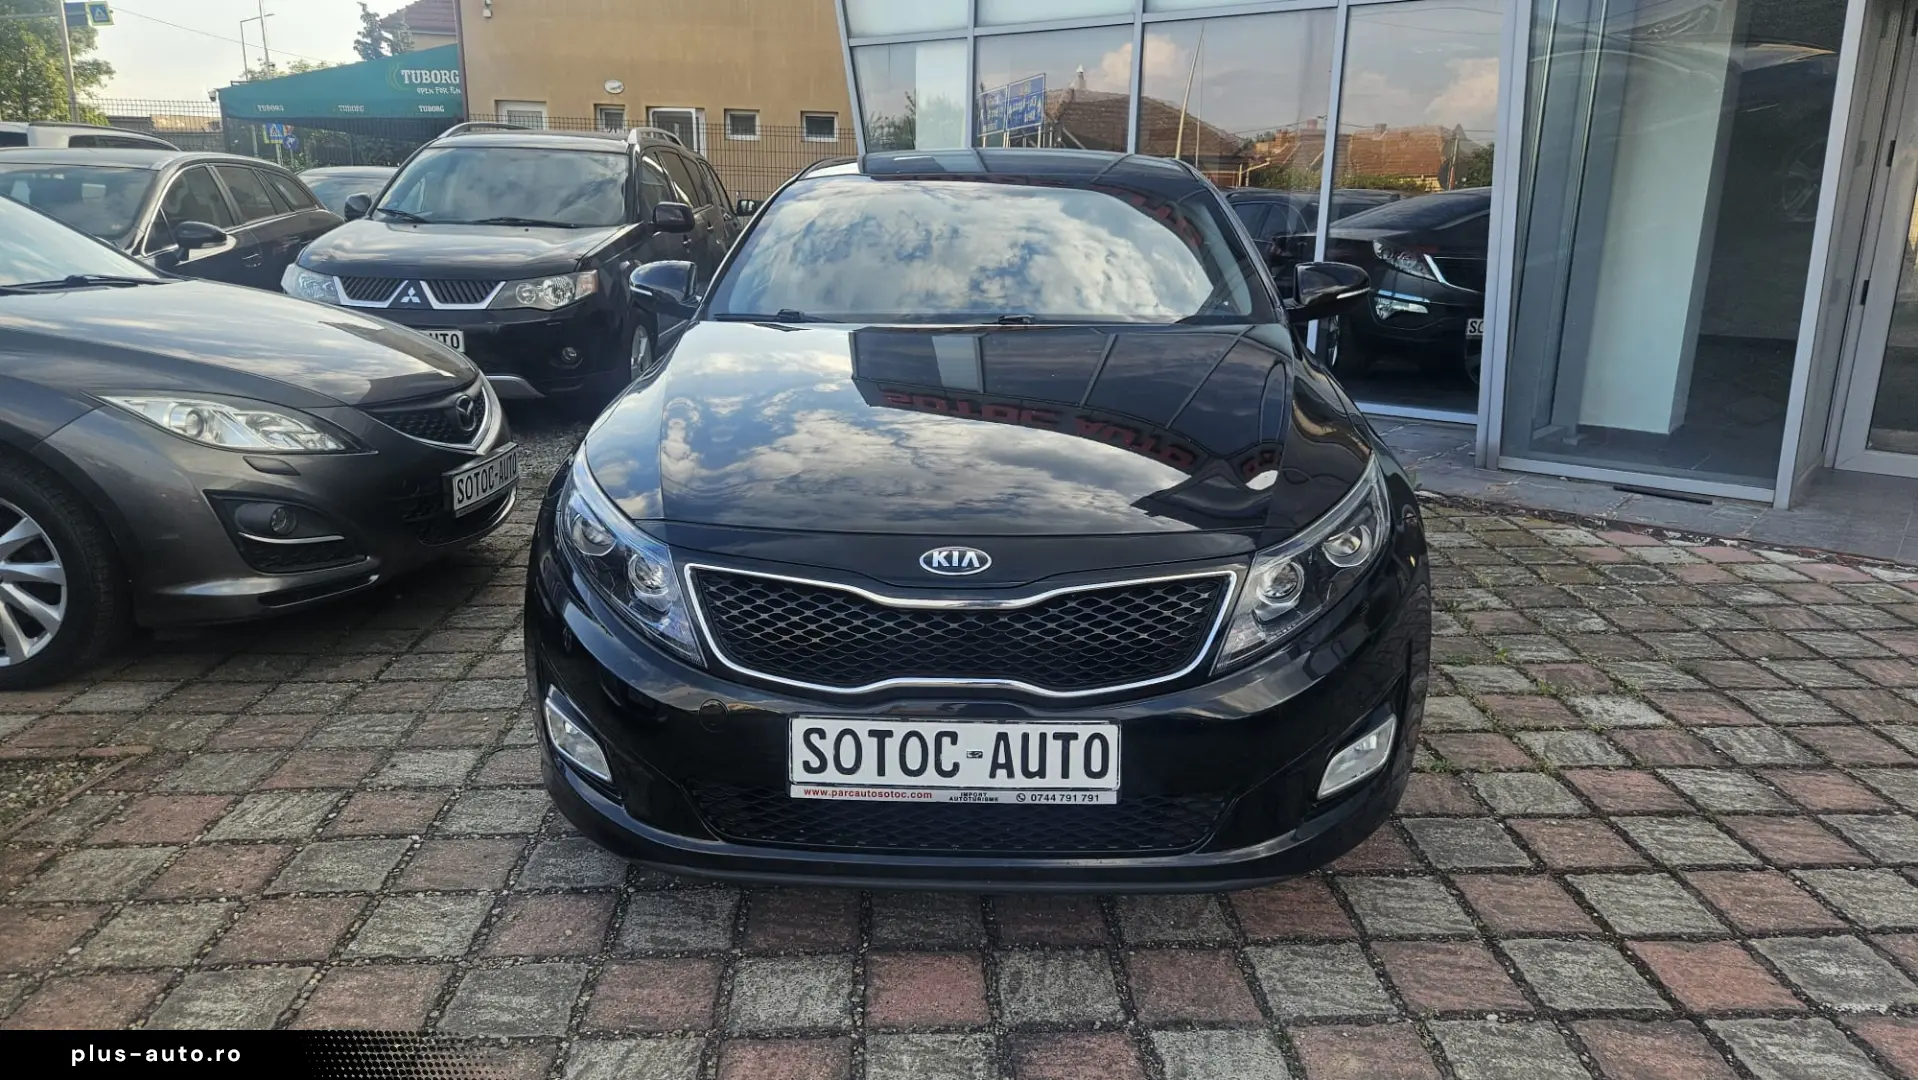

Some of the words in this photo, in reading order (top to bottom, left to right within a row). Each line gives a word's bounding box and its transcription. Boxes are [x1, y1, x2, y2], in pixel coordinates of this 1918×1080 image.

[401, 69, 460, 84] TUBORG
[932, 551, 980, 568] KIA
[803, 788, 933, 799] www.parcautosotoc.com
[1030, 793, 1056, 802] 0744
[1060, 793, 1078, 803] 791
[1081, 794, 1100, 803] 791
